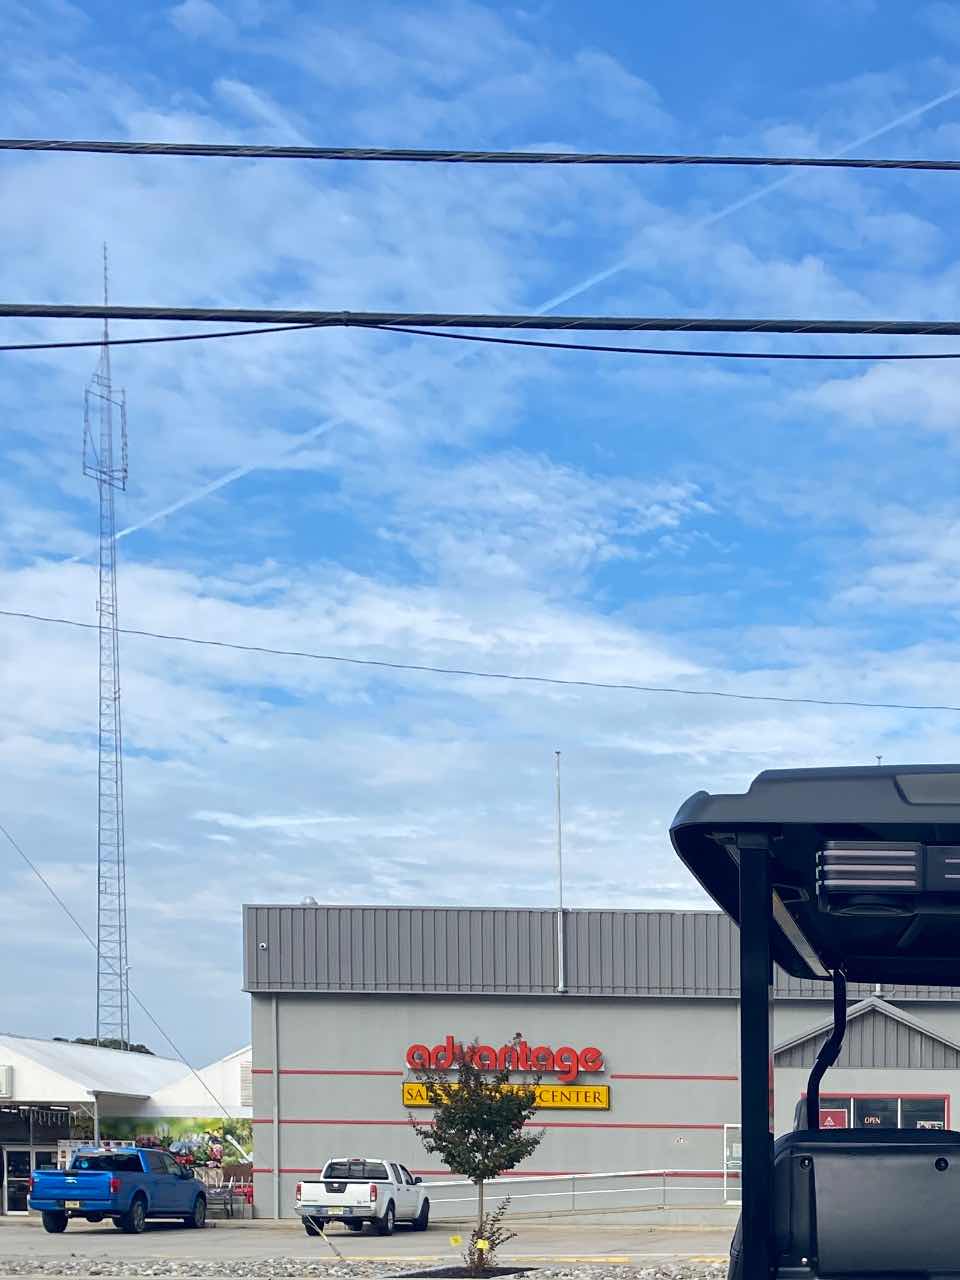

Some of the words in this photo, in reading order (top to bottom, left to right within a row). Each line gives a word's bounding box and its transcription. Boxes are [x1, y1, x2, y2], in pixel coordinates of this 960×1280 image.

[405, 1035, 604, 1082] advantage
[539, 1089, 602, 1103] CENTER
[864, 1115, 880, 1124] OPEN
